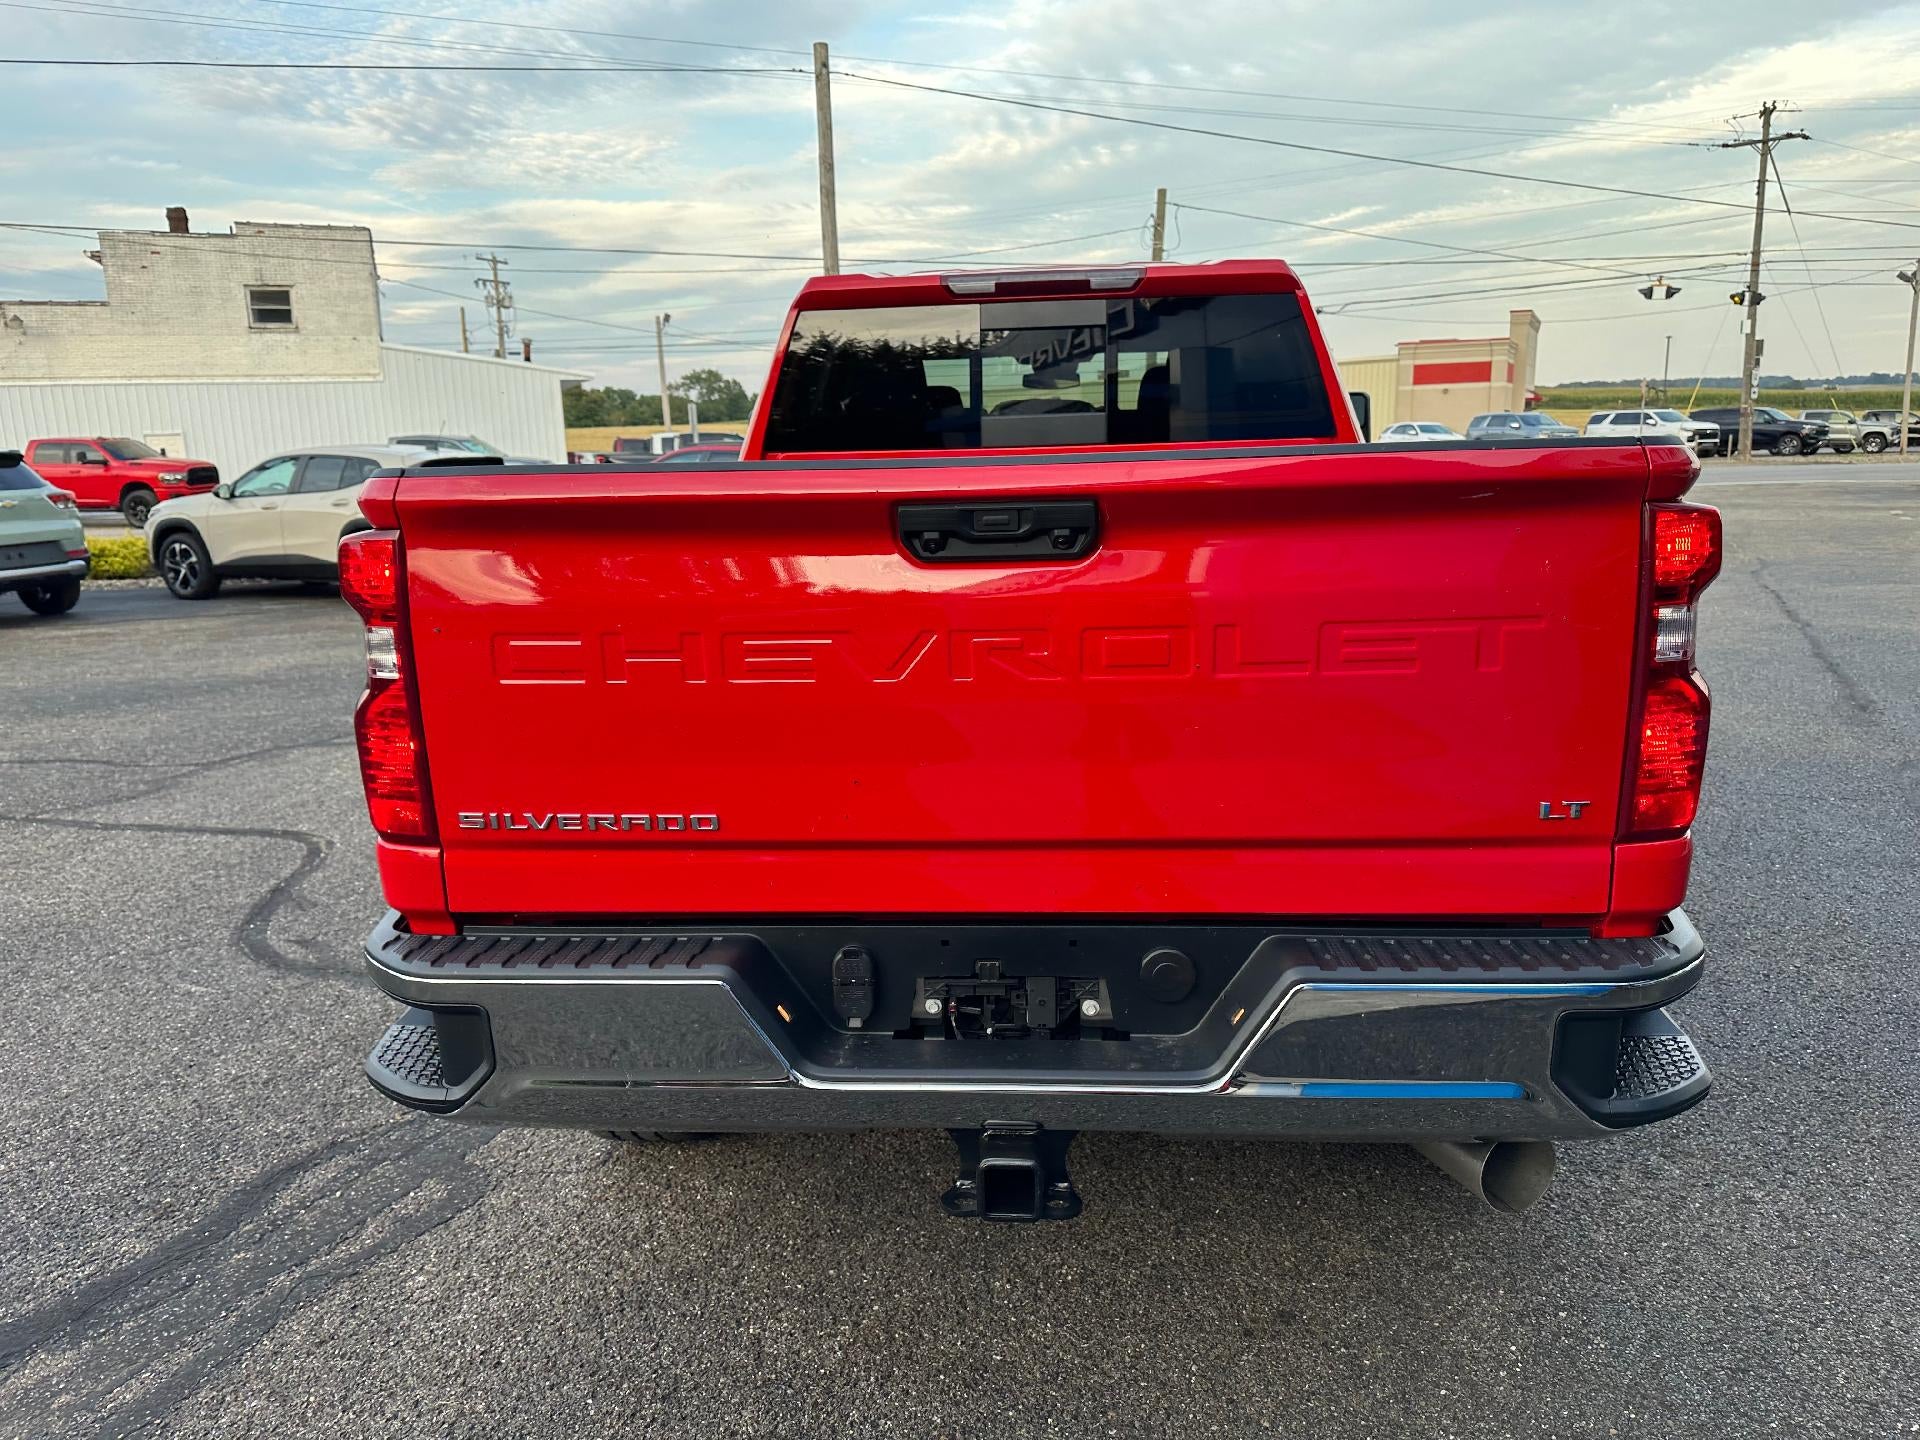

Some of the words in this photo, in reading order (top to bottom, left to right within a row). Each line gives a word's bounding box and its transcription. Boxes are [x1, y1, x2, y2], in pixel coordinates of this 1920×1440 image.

[490, 614, 1547, 688] CHEVROLET
[1539, 800, 1591, 819] LT
[458, 811, 720, 831] SILVERADO
